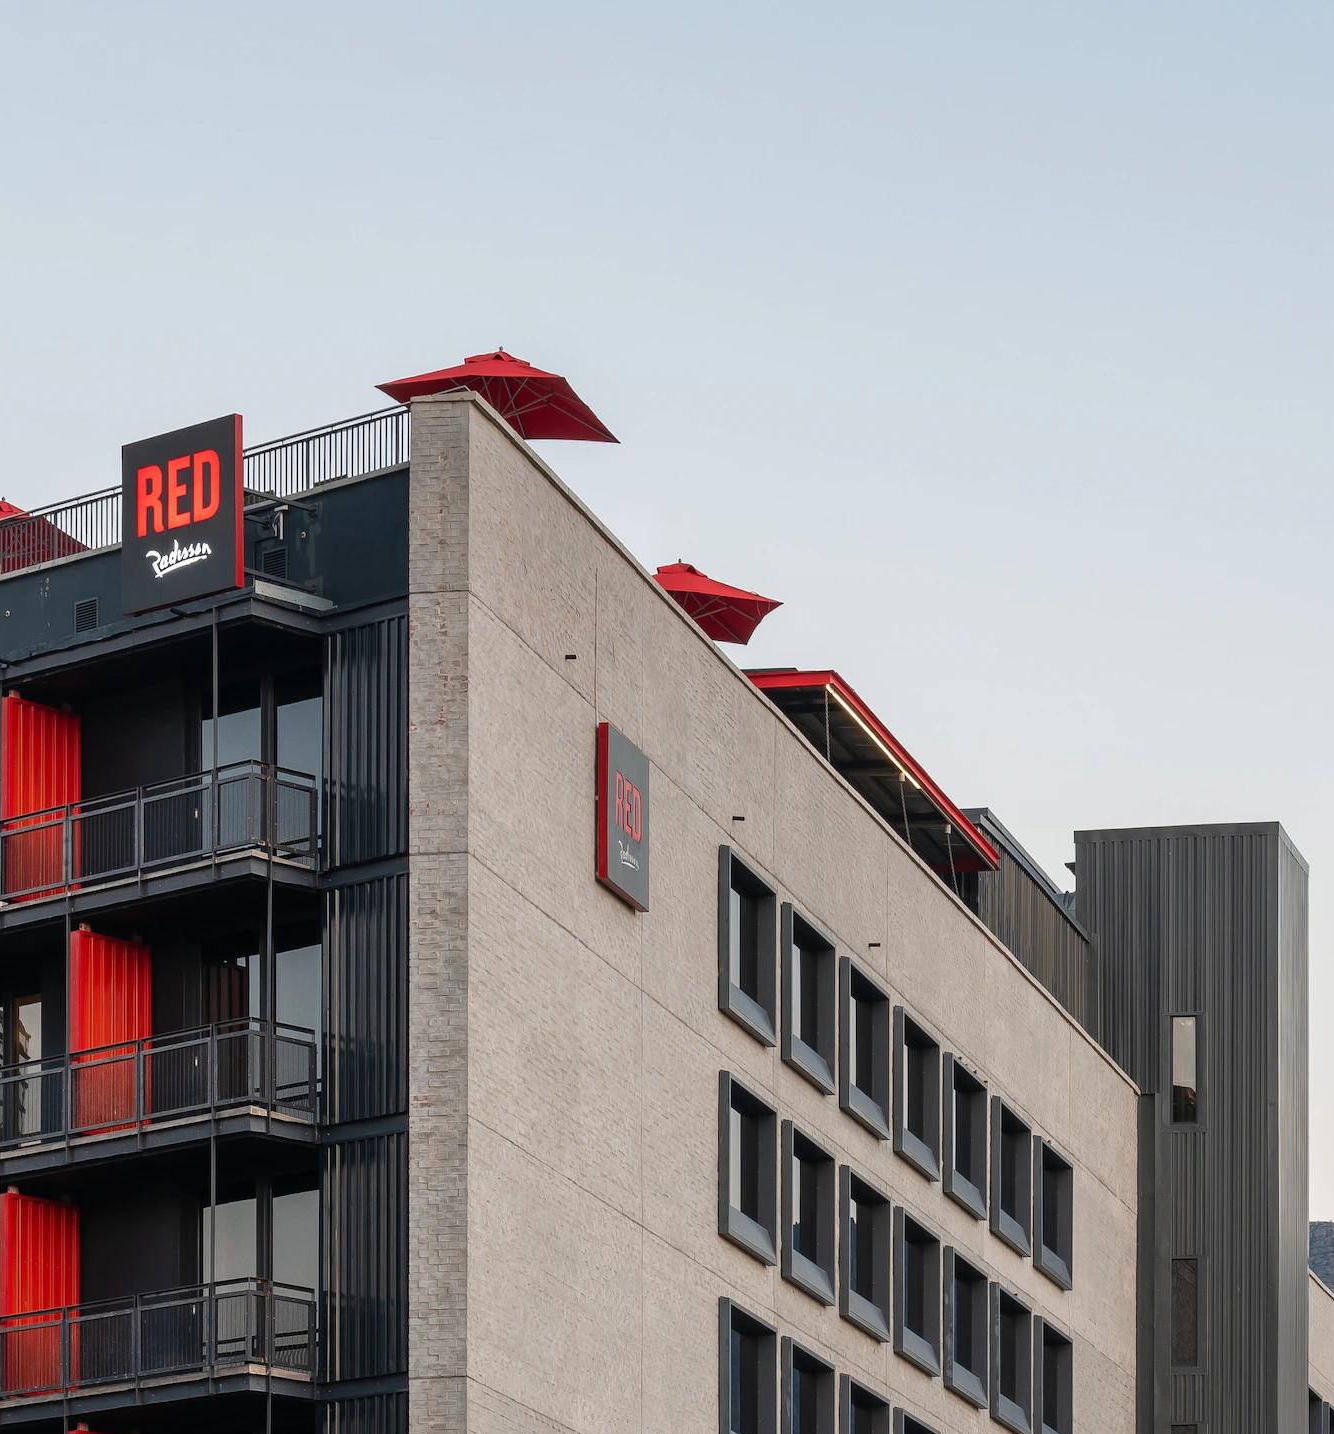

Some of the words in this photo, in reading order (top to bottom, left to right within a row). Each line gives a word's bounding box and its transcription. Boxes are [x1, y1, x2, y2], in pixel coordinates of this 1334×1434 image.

[137, 449, 220, 538] RED
[146, 539, 212, 578] Radisson
[615, 769, 642, 843] RED
